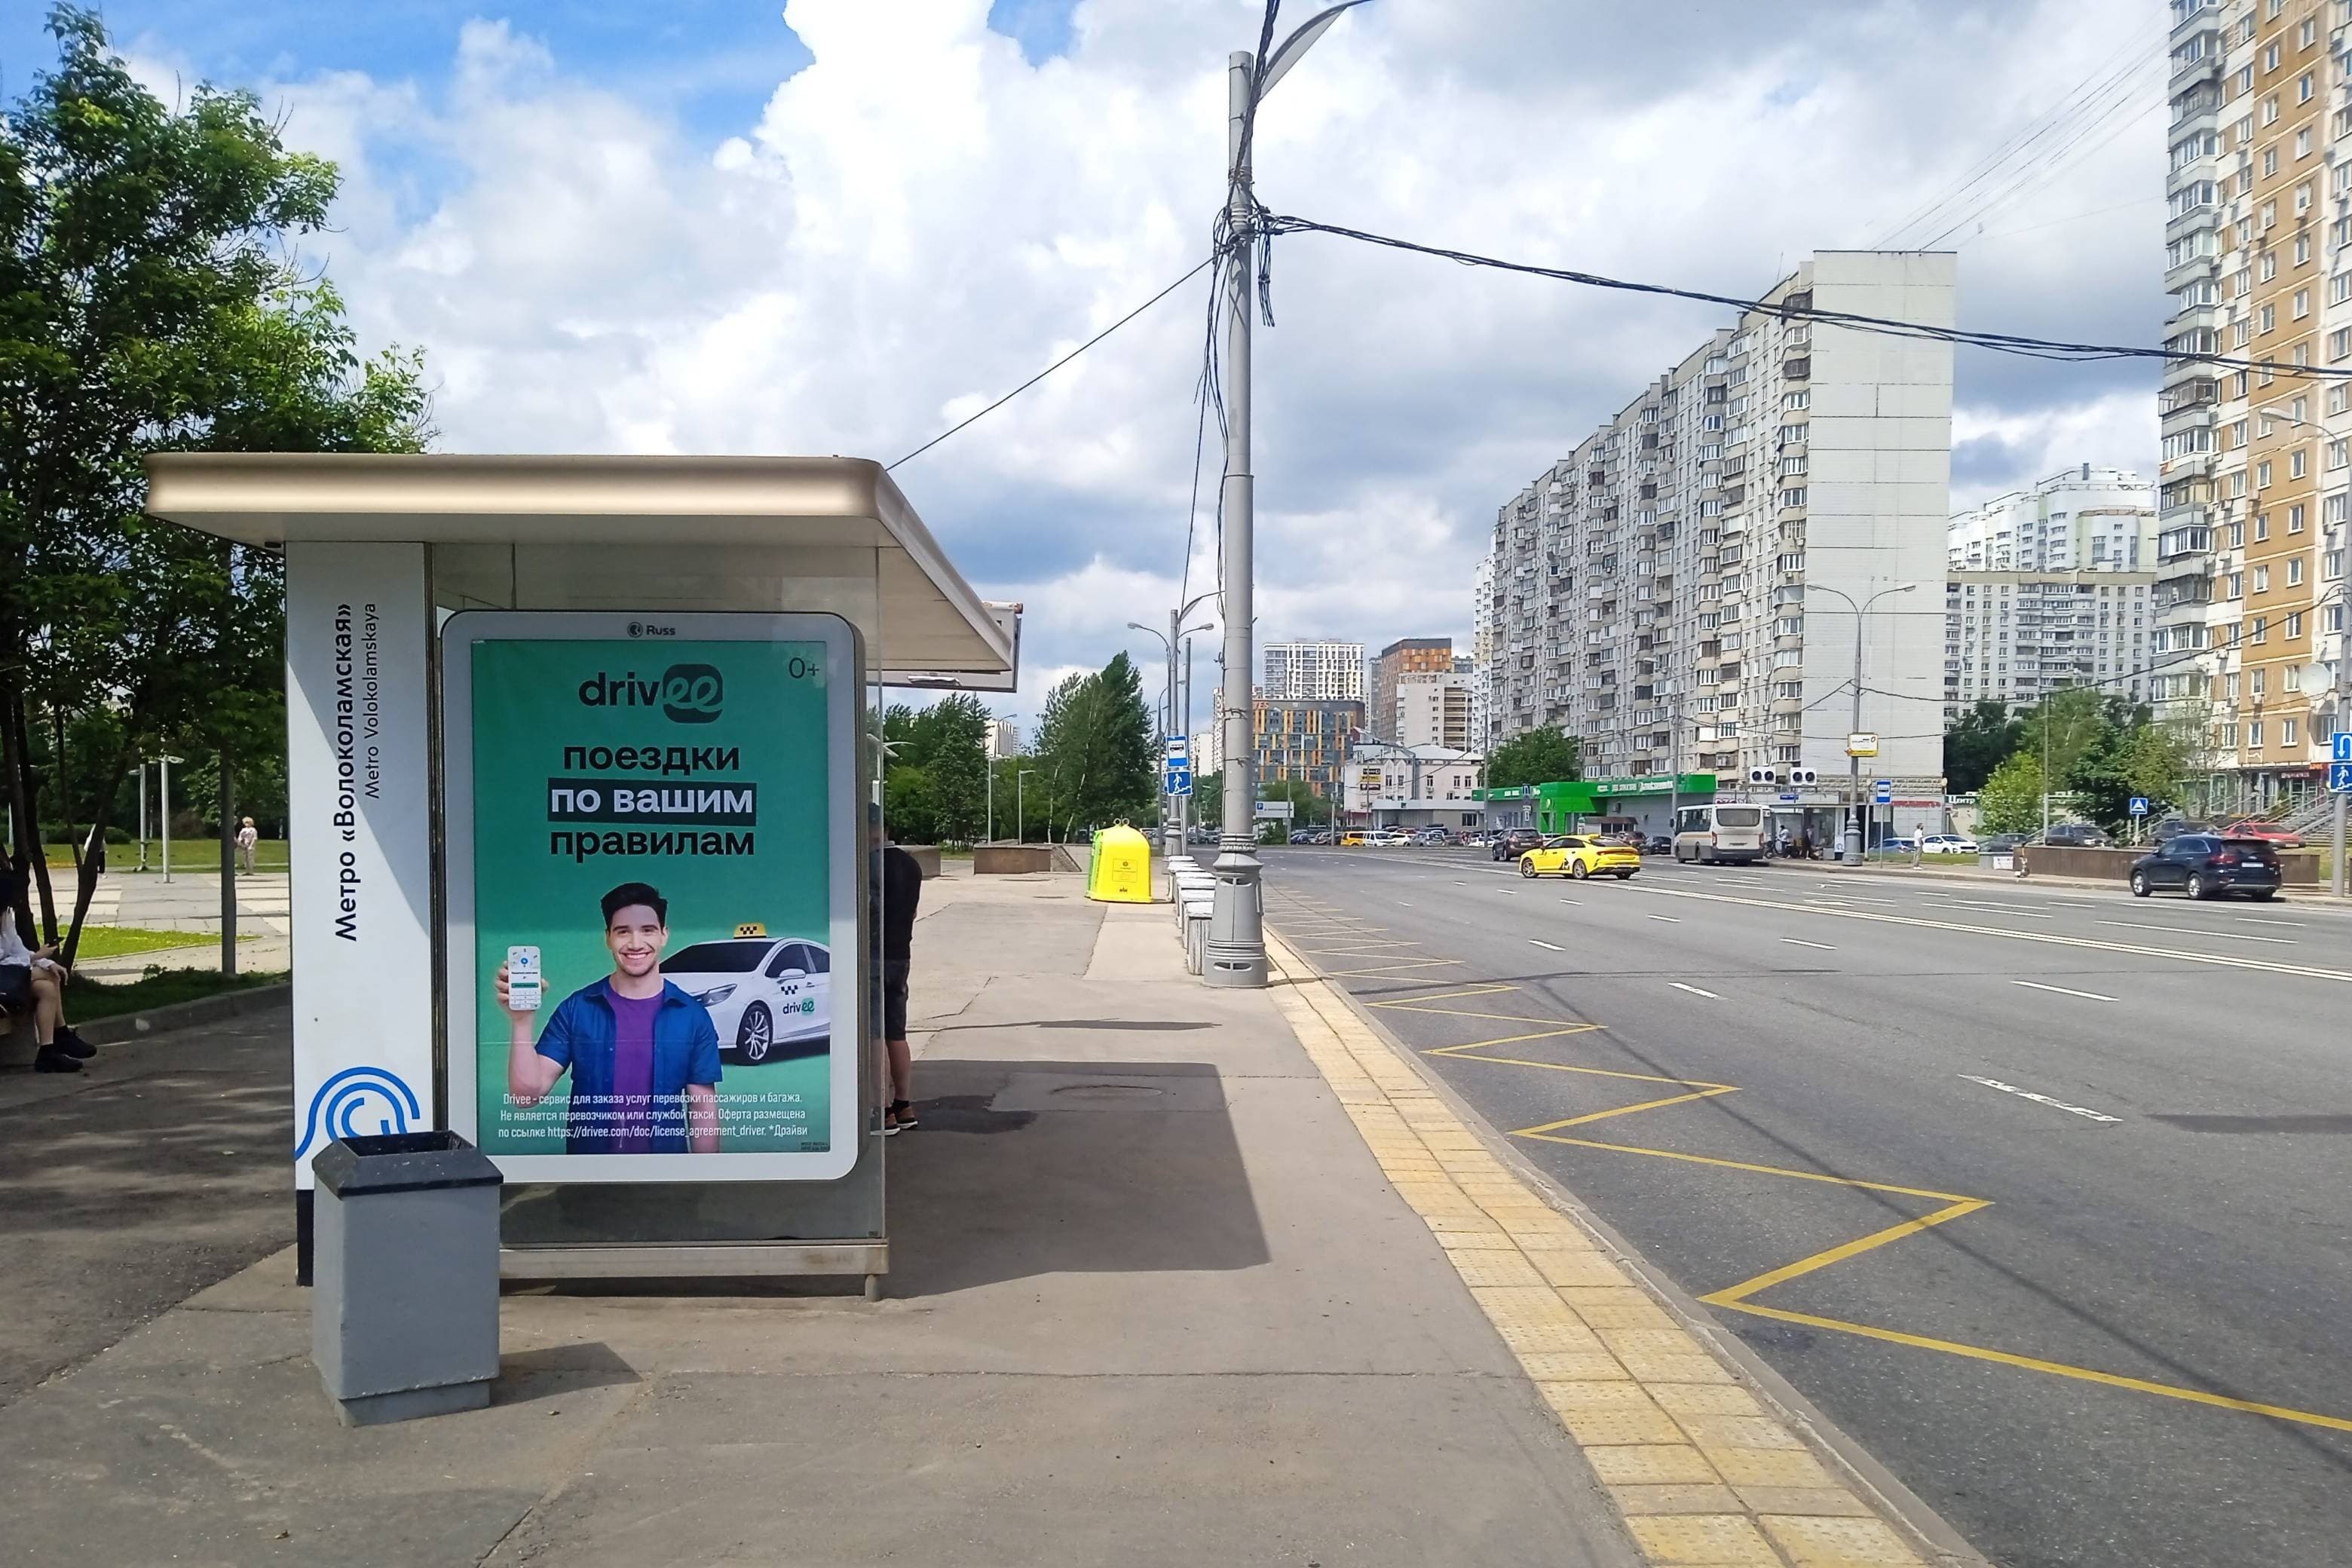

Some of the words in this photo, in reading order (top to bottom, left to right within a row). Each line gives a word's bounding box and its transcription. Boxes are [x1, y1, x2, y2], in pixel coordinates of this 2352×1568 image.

[646, 624, 676, 636] Russ
[362, 603, 379, 739] Volokolamskaya
[788, 657, 820, 679] 0+
[578, 667, 724, 716] drivee
[333, 603, 357, 844] «Волоколамская»
[364, 746, 380, 799] Metro
[563, 745, 740, 776] поездки
[551, 789, 601, 813] по
[613, 789, 753, 813] вашим
[550, 831, 755, 863] правилам
[335, 852, 362, 942] Метро
[782, 999, 815, 1015] drivee
[503, 1093, 531, 1104] Drivee
[538, 1095, 571, 1106] сервис
[573, 1095, 591, 1106] для
[593, 1095, 624, 1104] заказа
[626, 1095, 651, 1107] услуг
[653, 1094, 702, 1106] перевозки
[703, 1094, 758, 1105] пассажиров
[760, 1094, 766, 1103] и
[767, 1092, 802, 1104] багажа.
[500, 1110, 512, 1121] Не
[513, 1111, 557, 1121] является
[559, 1111, 625, 1123] перевозчиком
[626, 1111, 645, 1121] или
[646, 1109, 686, 1122] службой
[688, 1110, 716, 1120] такси.
[718, 1108, 752, 1121] Оферта
[753, 1110, 806, 1122] размещена
[498, 1127, 510, 1138] по
[511, 1128, 546, 1138] ссылке
